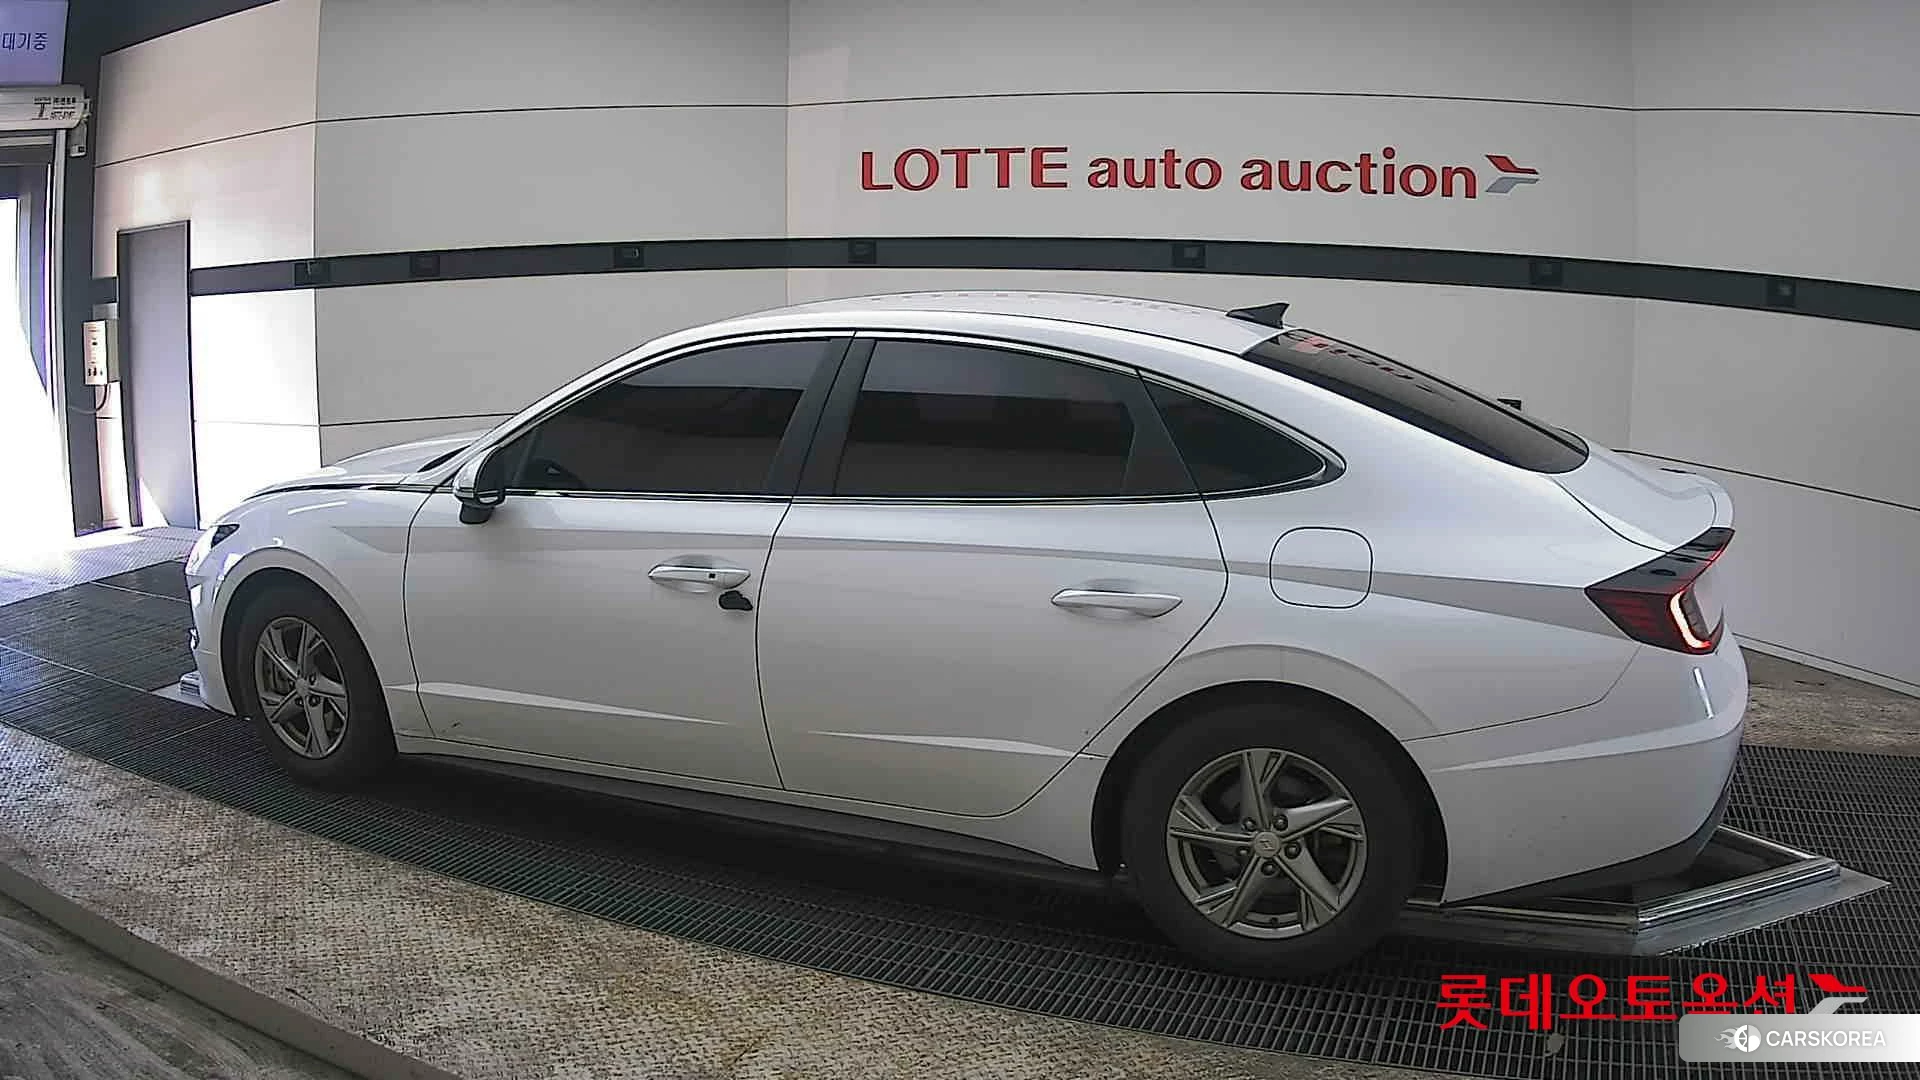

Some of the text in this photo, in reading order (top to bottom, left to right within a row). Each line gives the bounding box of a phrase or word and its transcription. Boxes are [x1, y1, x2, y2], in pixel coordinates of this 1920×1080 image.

[2, 31, 49, 51] 대기중
[860, 146, 1479, 199] LOTTE auto auction
